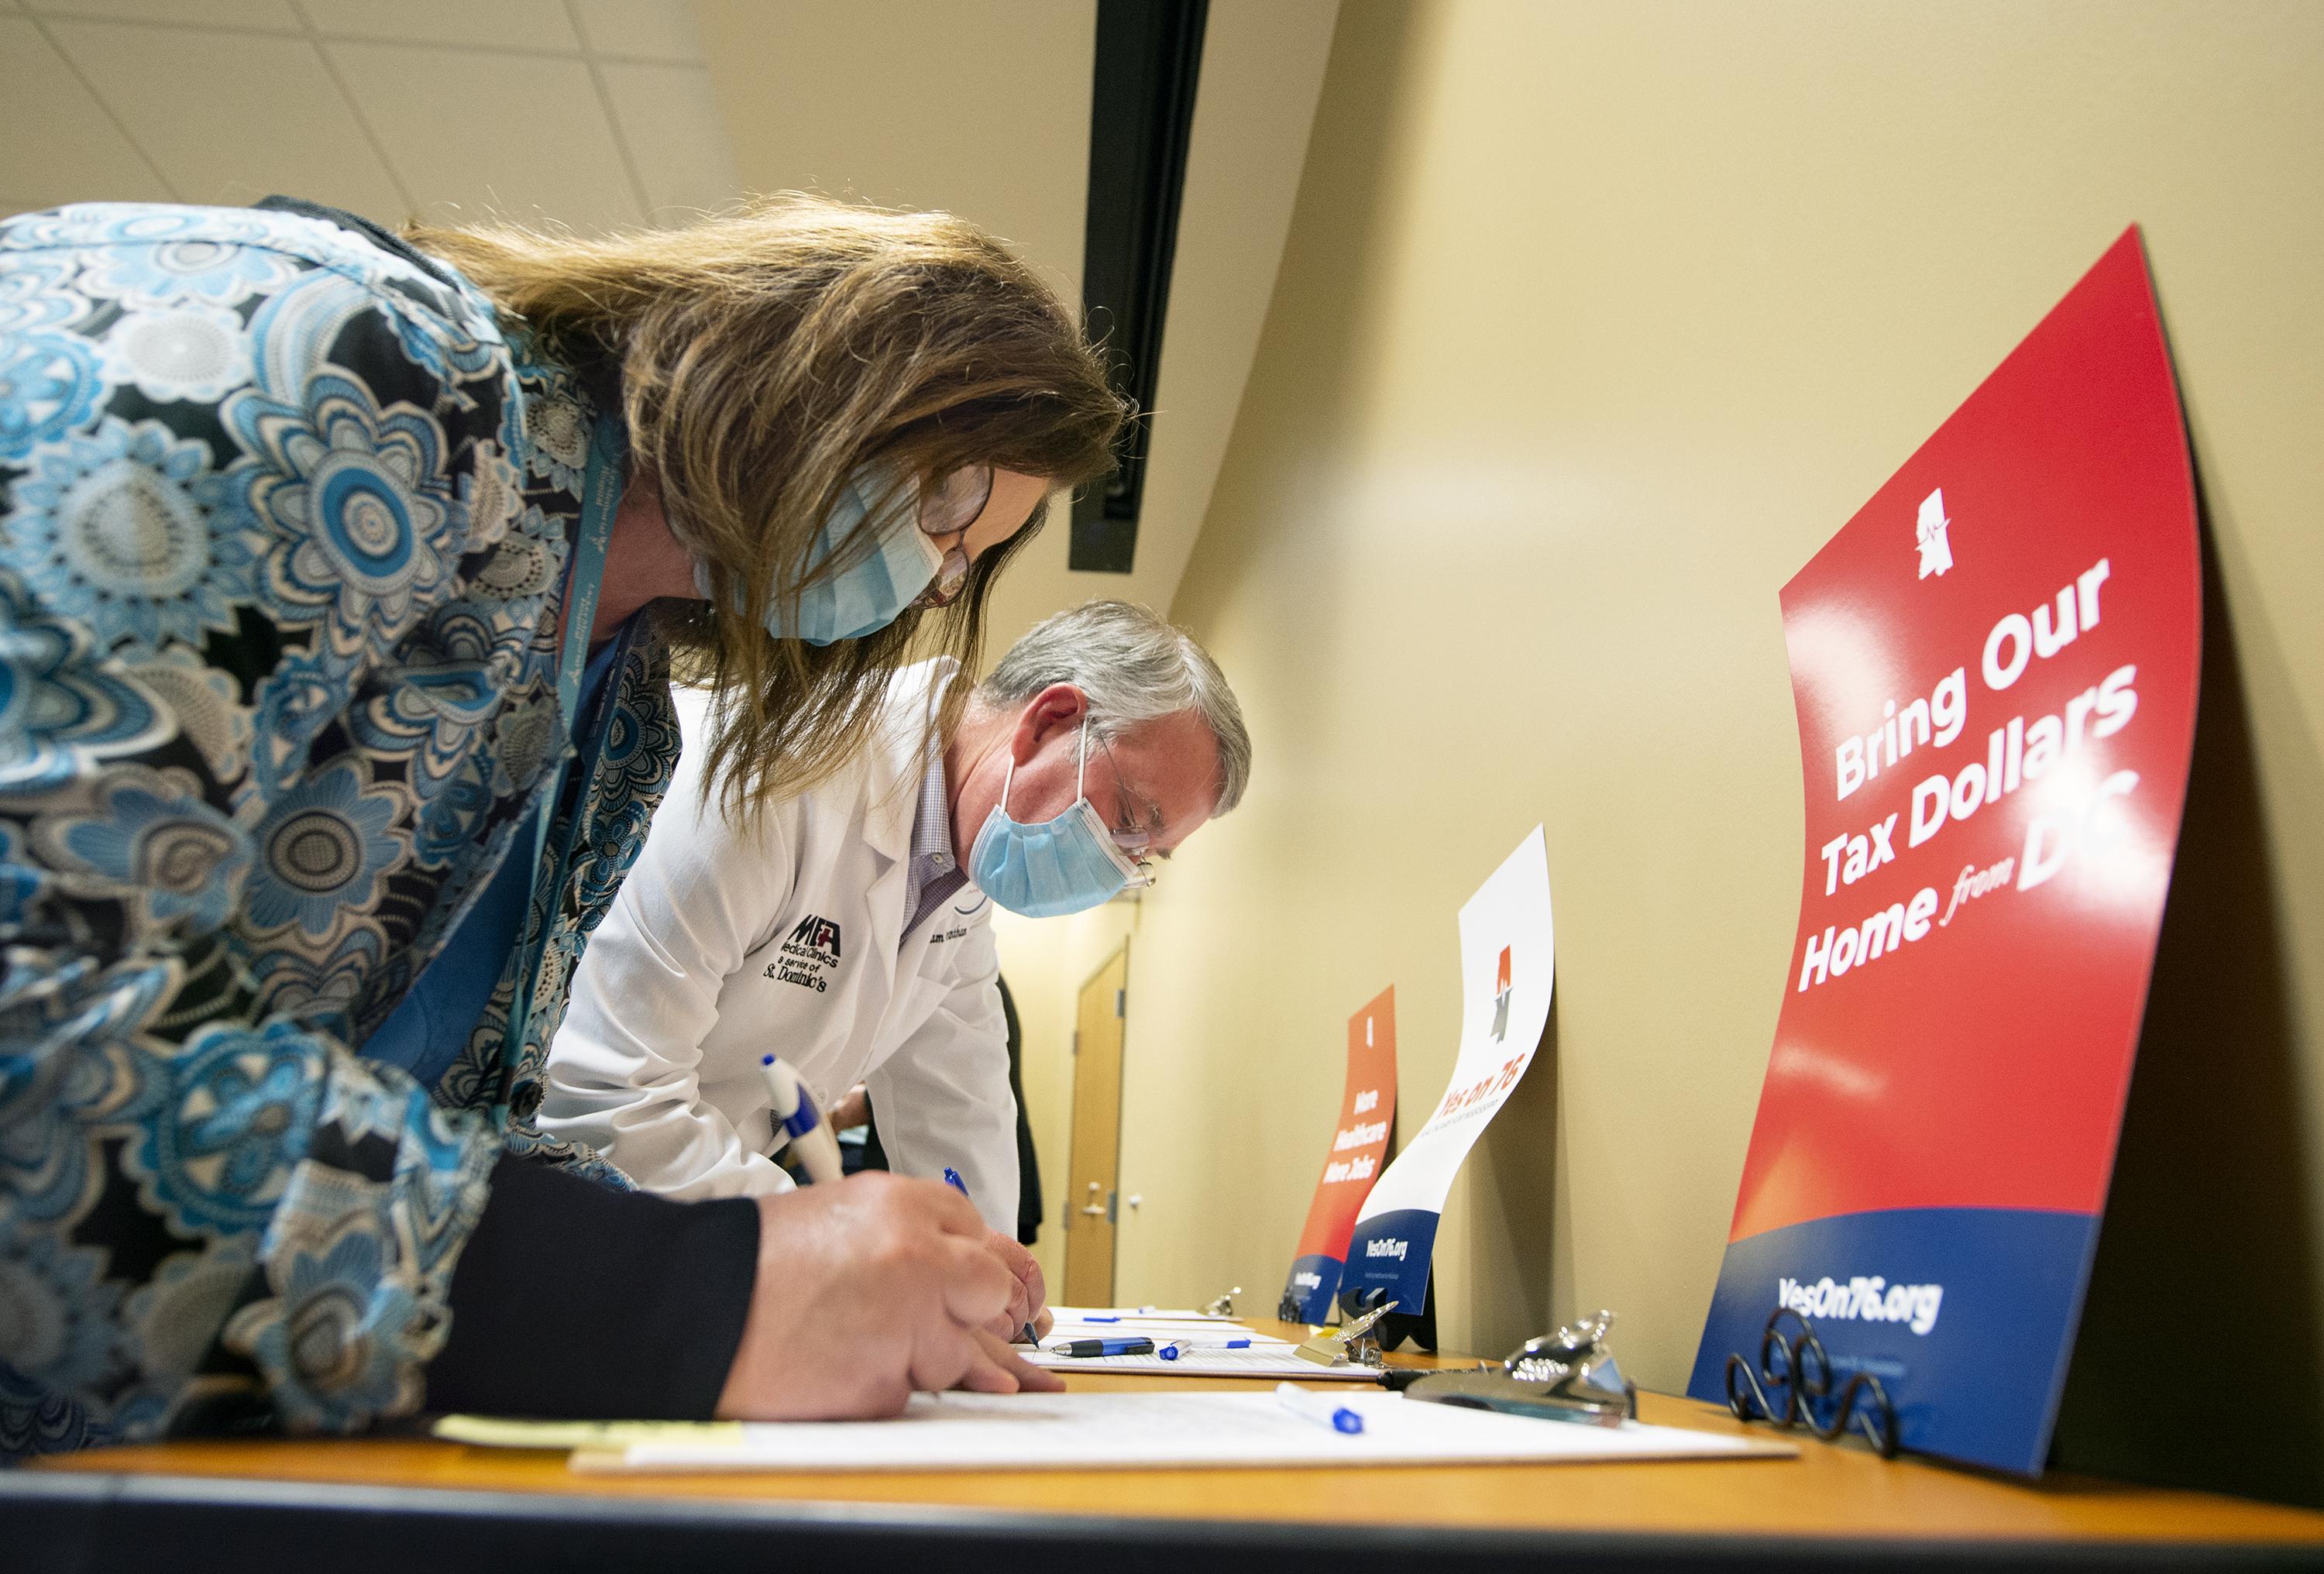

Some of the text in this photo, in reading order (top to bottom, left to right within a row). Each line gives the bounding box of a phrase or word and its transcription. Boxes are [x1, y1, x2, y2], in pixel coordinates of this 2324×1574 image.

[1836, 557, 2111, 802] Bring Our
[1820, 664, 2139, 896] Tax Dollars
[1797, 887, 1939, 993] Home
[1938, 856, 2015, 927] from
[776, 965, 827, 993] Dominic's
[785, 957, 809, 970] service
[809, 963, 822, 974] of
[806, 946, 839, 968] Clinics
[1779, 1275, 1944, 1336] YesOn76.org
